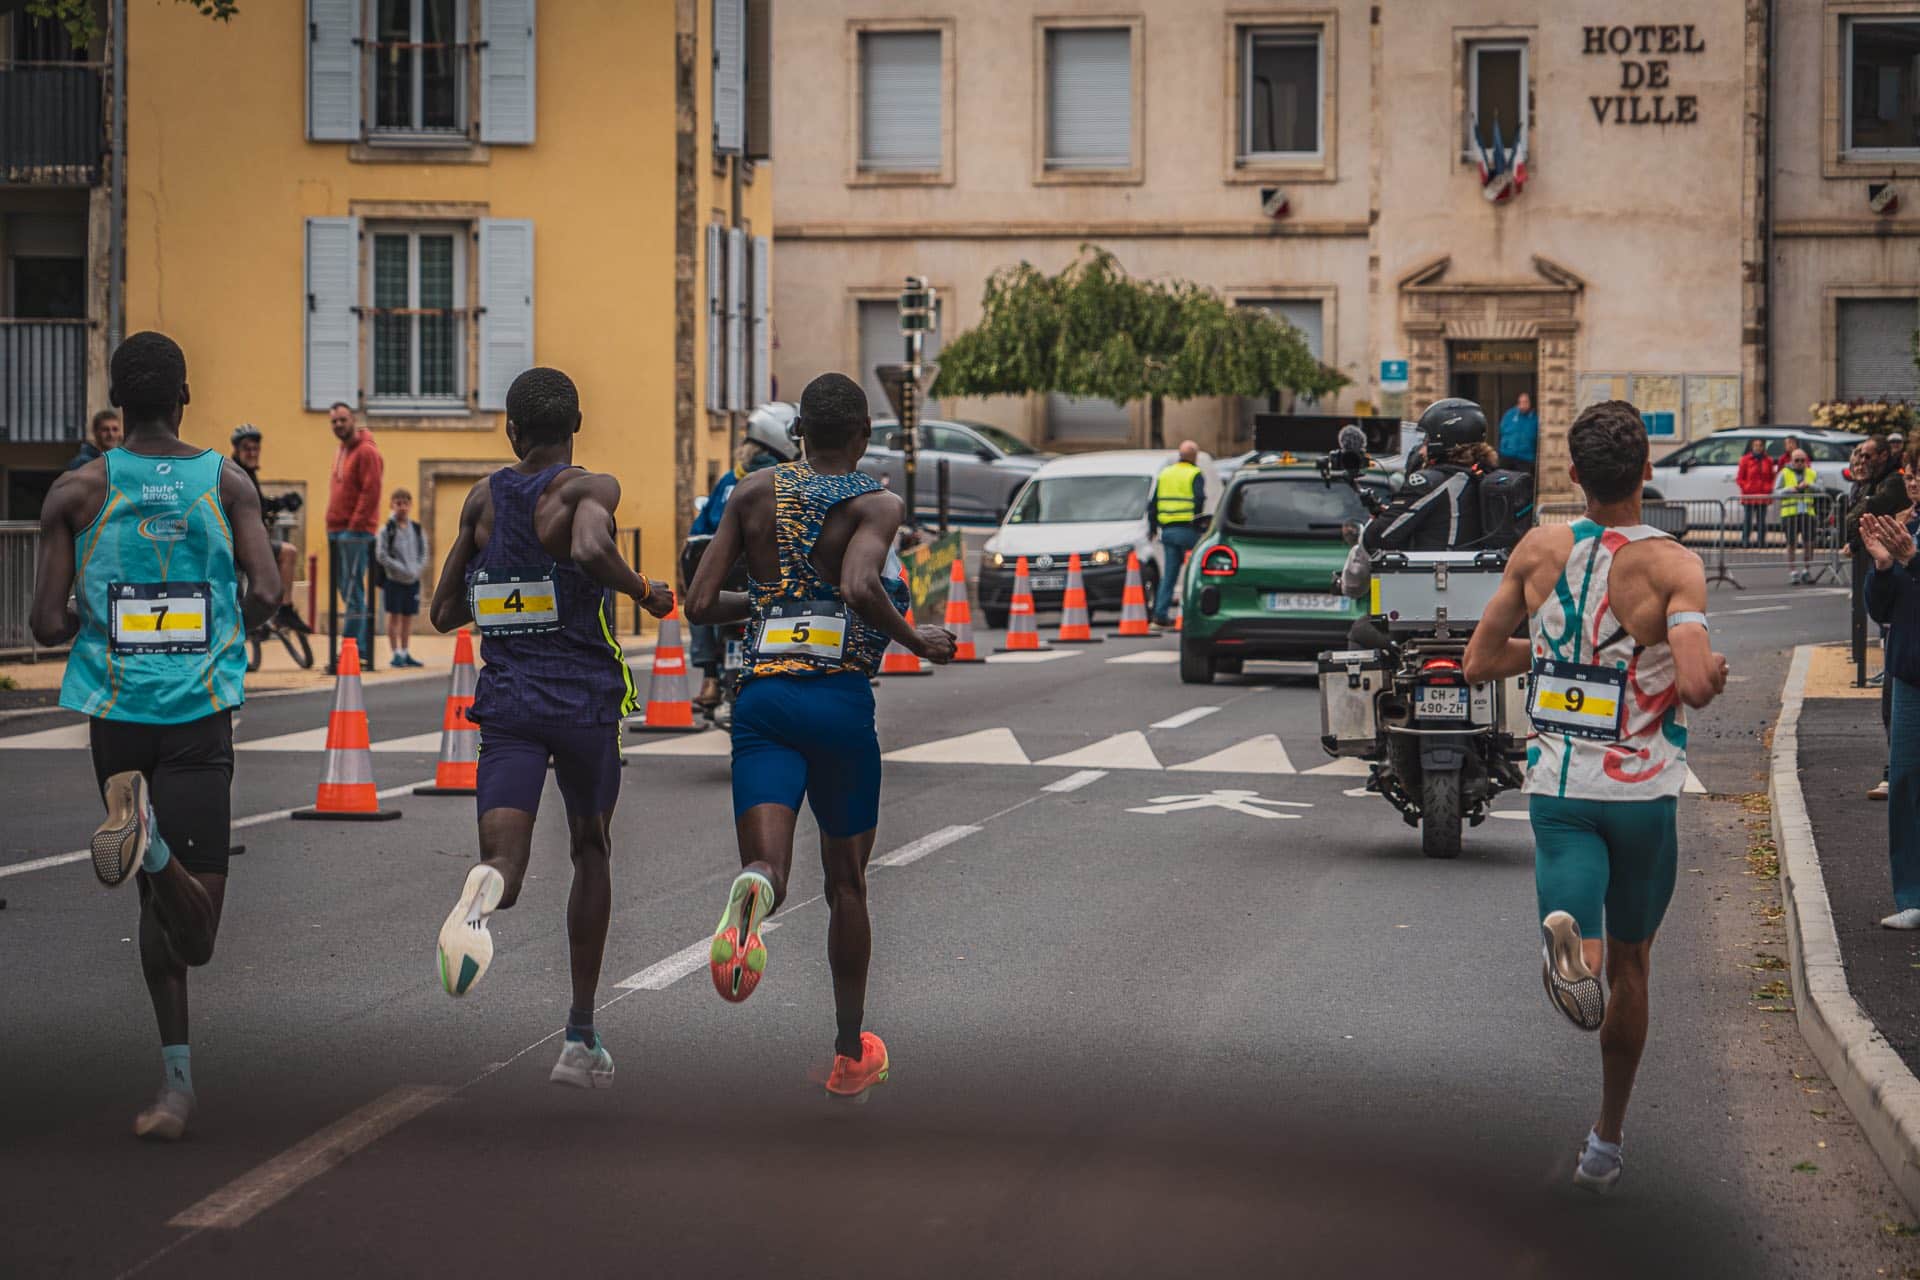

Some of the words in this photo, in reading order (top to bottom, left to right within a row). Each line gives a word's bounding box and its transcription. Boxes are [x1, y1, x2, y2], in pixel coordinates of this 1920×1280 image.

[1582, 25, 1705, 54] HOTEL
[1620, 60, 1670, 89] DE
[1589, 95, 1698, 125] VILLE
[142, 483, 174, 493] haute
[503, 588, 525, 613] 4
[150, 605, 169, 631] 7
[790, 621, 811, 643] 5
[1420, 703, 1464, 714] 490-ZH
[1564, 686, 1585, 713] 9
